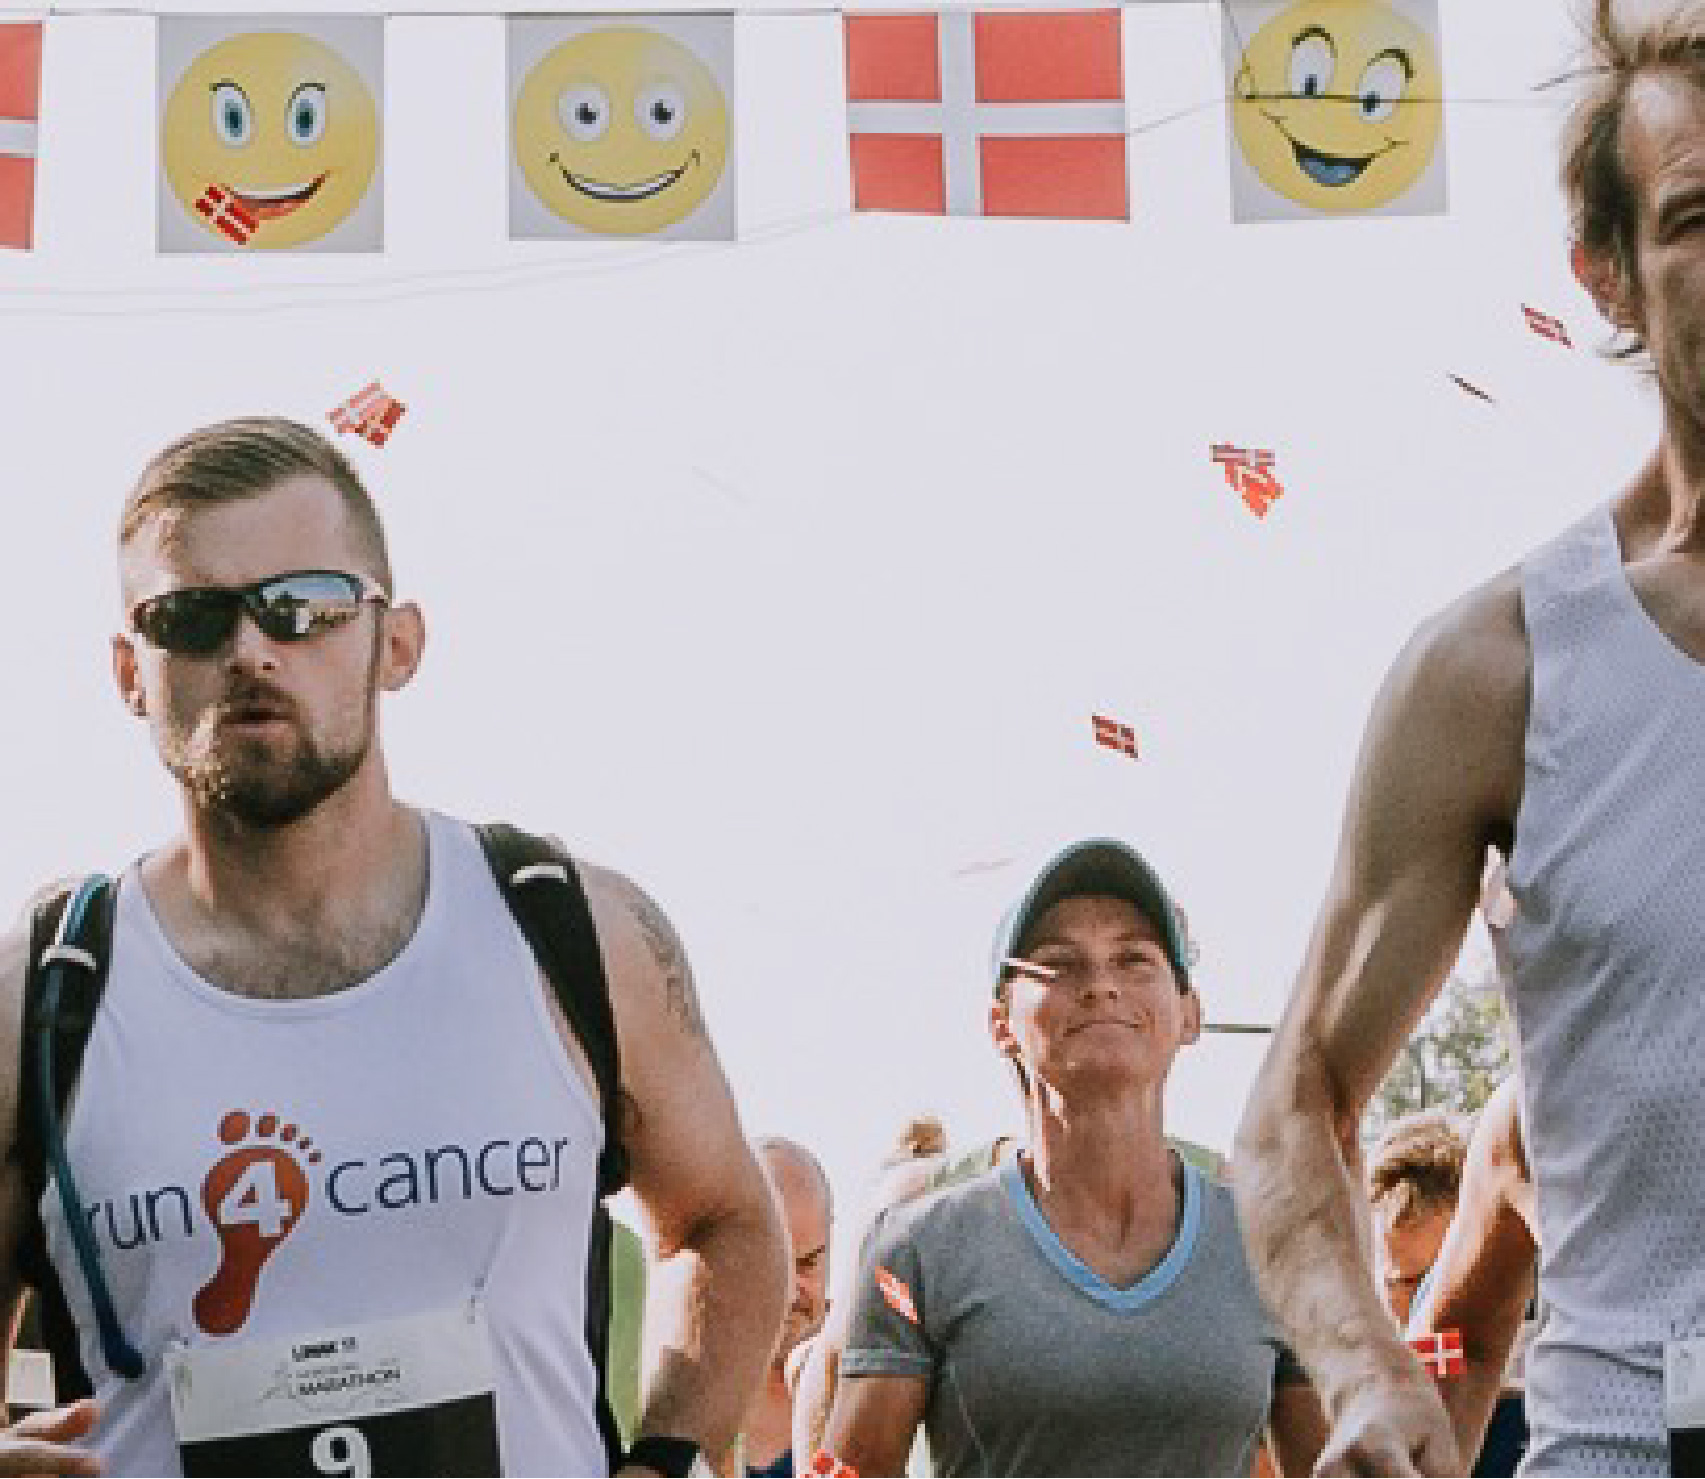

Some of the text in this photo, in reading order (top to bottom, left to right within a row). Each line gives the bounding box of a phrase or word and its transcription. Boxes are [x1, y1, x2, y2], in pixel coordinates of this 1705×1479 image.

[82, 1183, 193, 1251] run
[325, 1136, 568, 1216] cancer
[309, 1426, 372, 1478] 9
